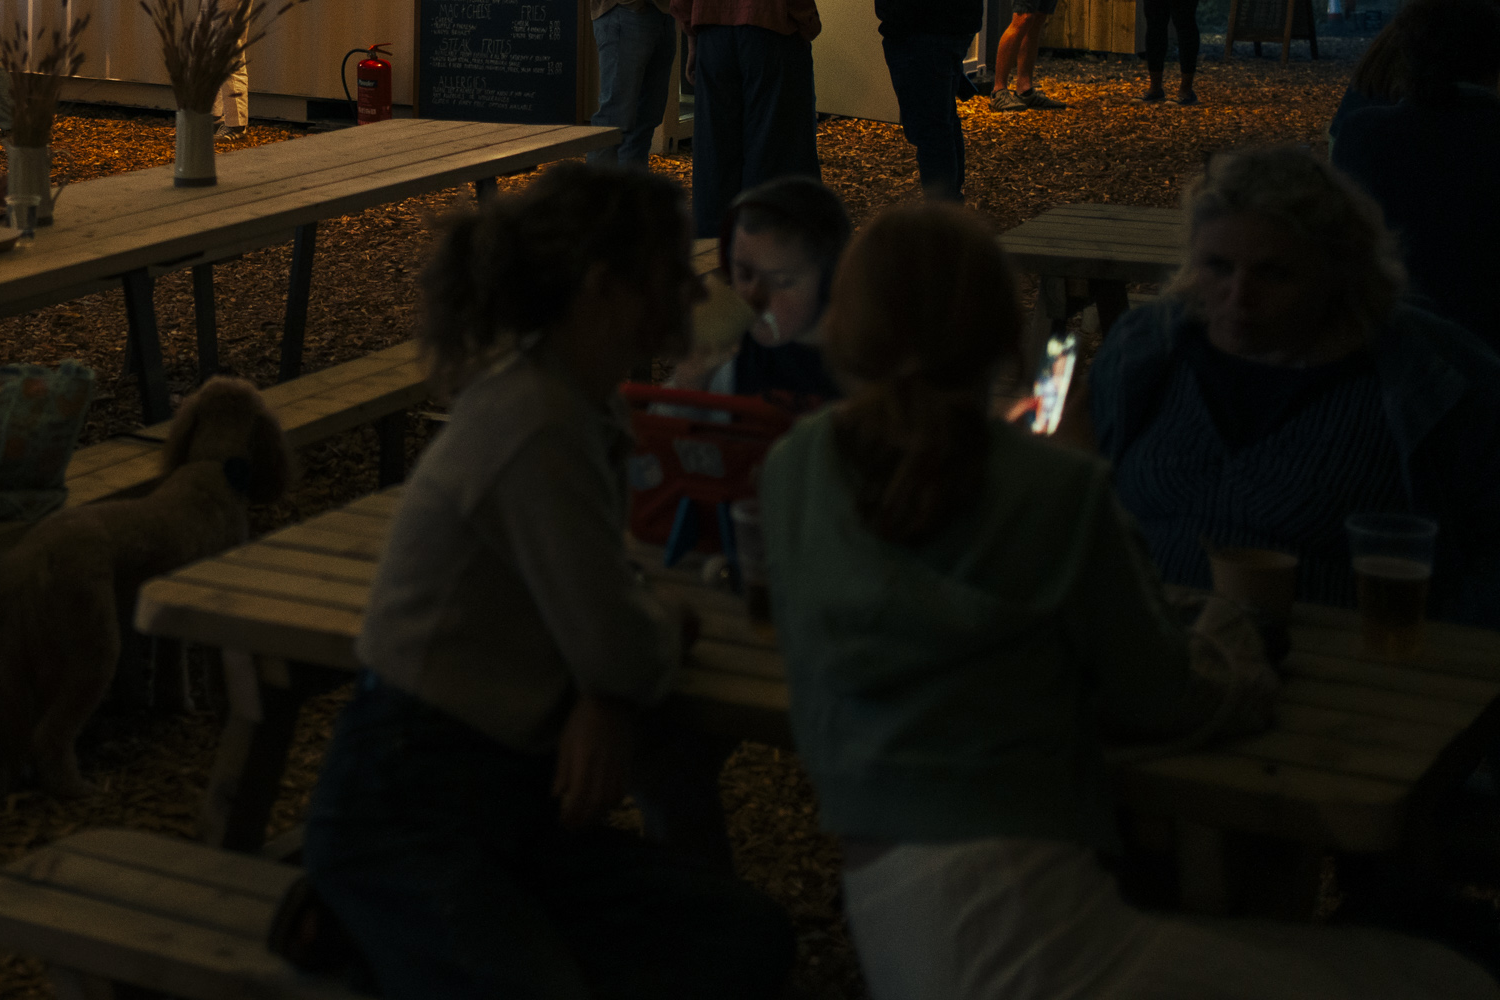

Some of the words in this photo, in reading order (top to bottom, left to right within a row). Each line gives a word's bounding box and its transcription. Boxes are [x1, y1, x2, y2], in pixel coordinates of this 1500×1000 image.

[439, 4, 458, 19] MAC
[466, 4, 491, 19] CHEESE
[521, 5, 546, 21] FRIES
[439, 38, 471, 52] STEAK
[481, 38, 512, 55] FRITES
[438, 75, 487, 89] ALLERGIES
